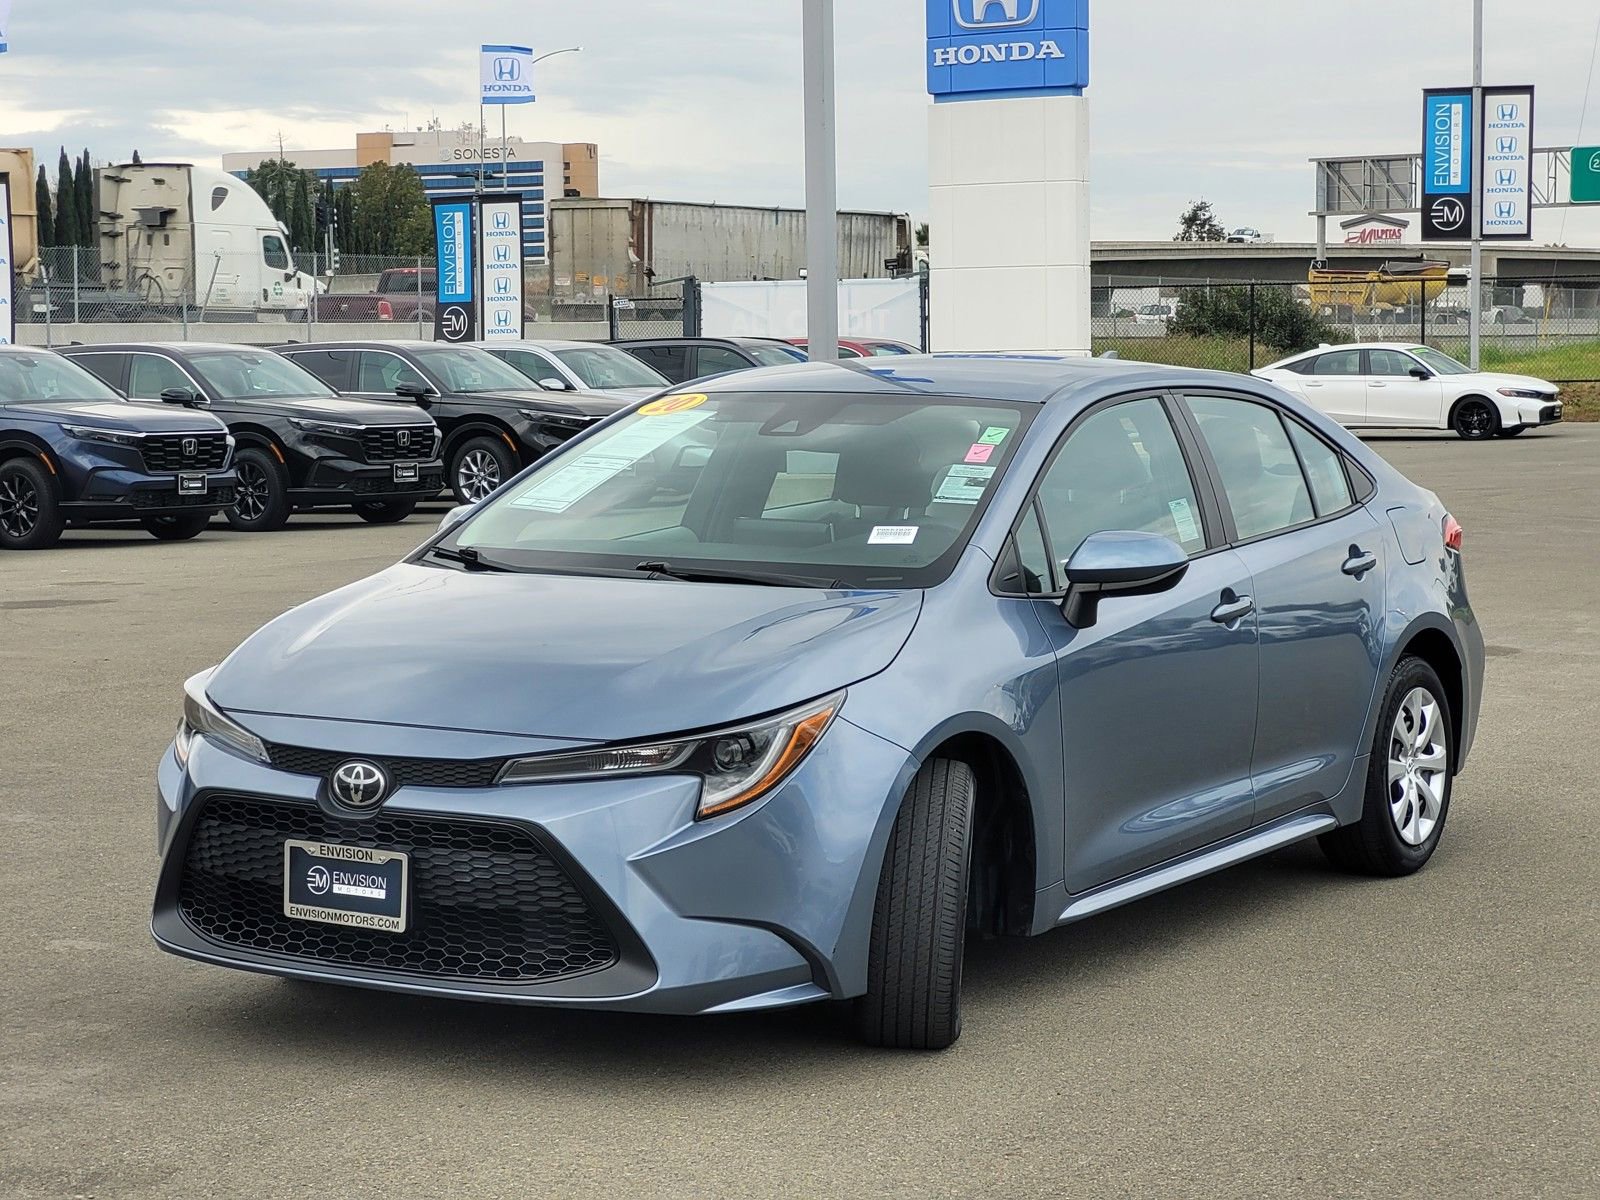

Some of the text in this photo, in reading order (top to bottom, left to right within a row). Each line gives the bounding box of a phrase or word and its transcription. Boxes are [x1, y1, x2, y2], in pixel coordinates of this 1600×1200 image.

[933, 40, 1065, 66] HONDA
[483, 84, 532, 92] HONDA
[1434, 103, 1450, 186] ENVISION
[441, 212, 456, 295] ENVISION
[319, 845, 373, 861] ENVISION
[332, 871, 387, 889] ENVISION
[337, 885, 382, 897] MOTORS
[289, 906, 400, 930] ENVISIONMOTORS.COM
